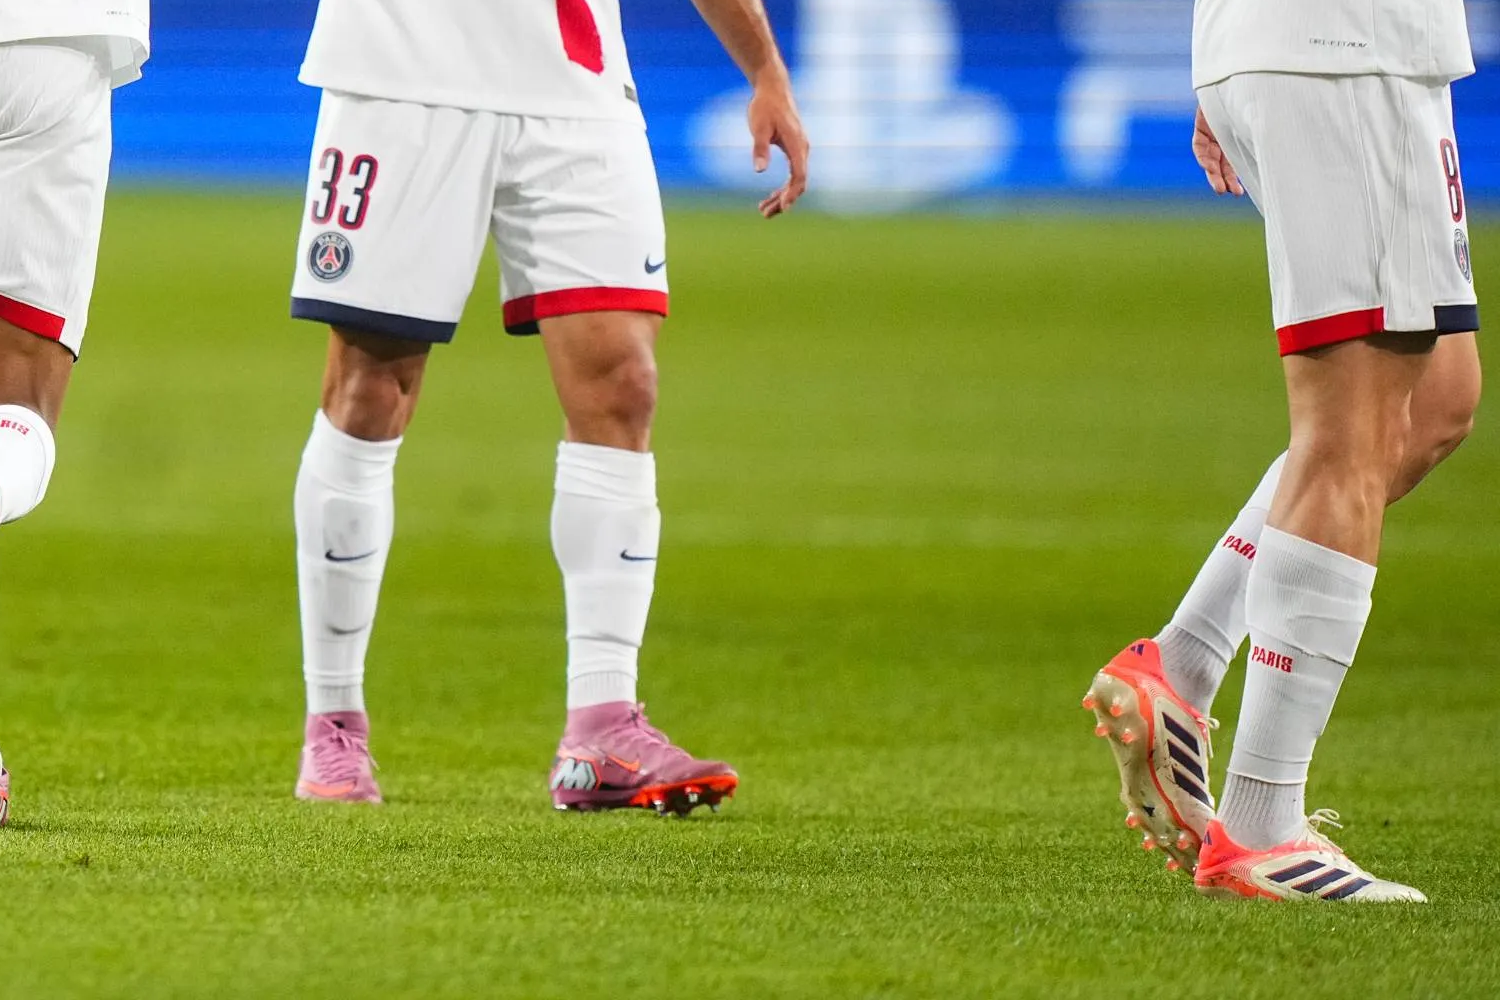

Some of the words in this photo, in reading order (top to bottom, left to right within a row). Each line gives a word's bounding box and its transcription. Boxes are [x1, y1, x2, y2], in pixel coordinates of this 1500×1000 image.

[311, 147, 378, 230] 33
[1440, 138, 1463, 223] 8
[1223, 535, 1257, 561] PARI
[1251, 646, 1294, 673] PARIS
